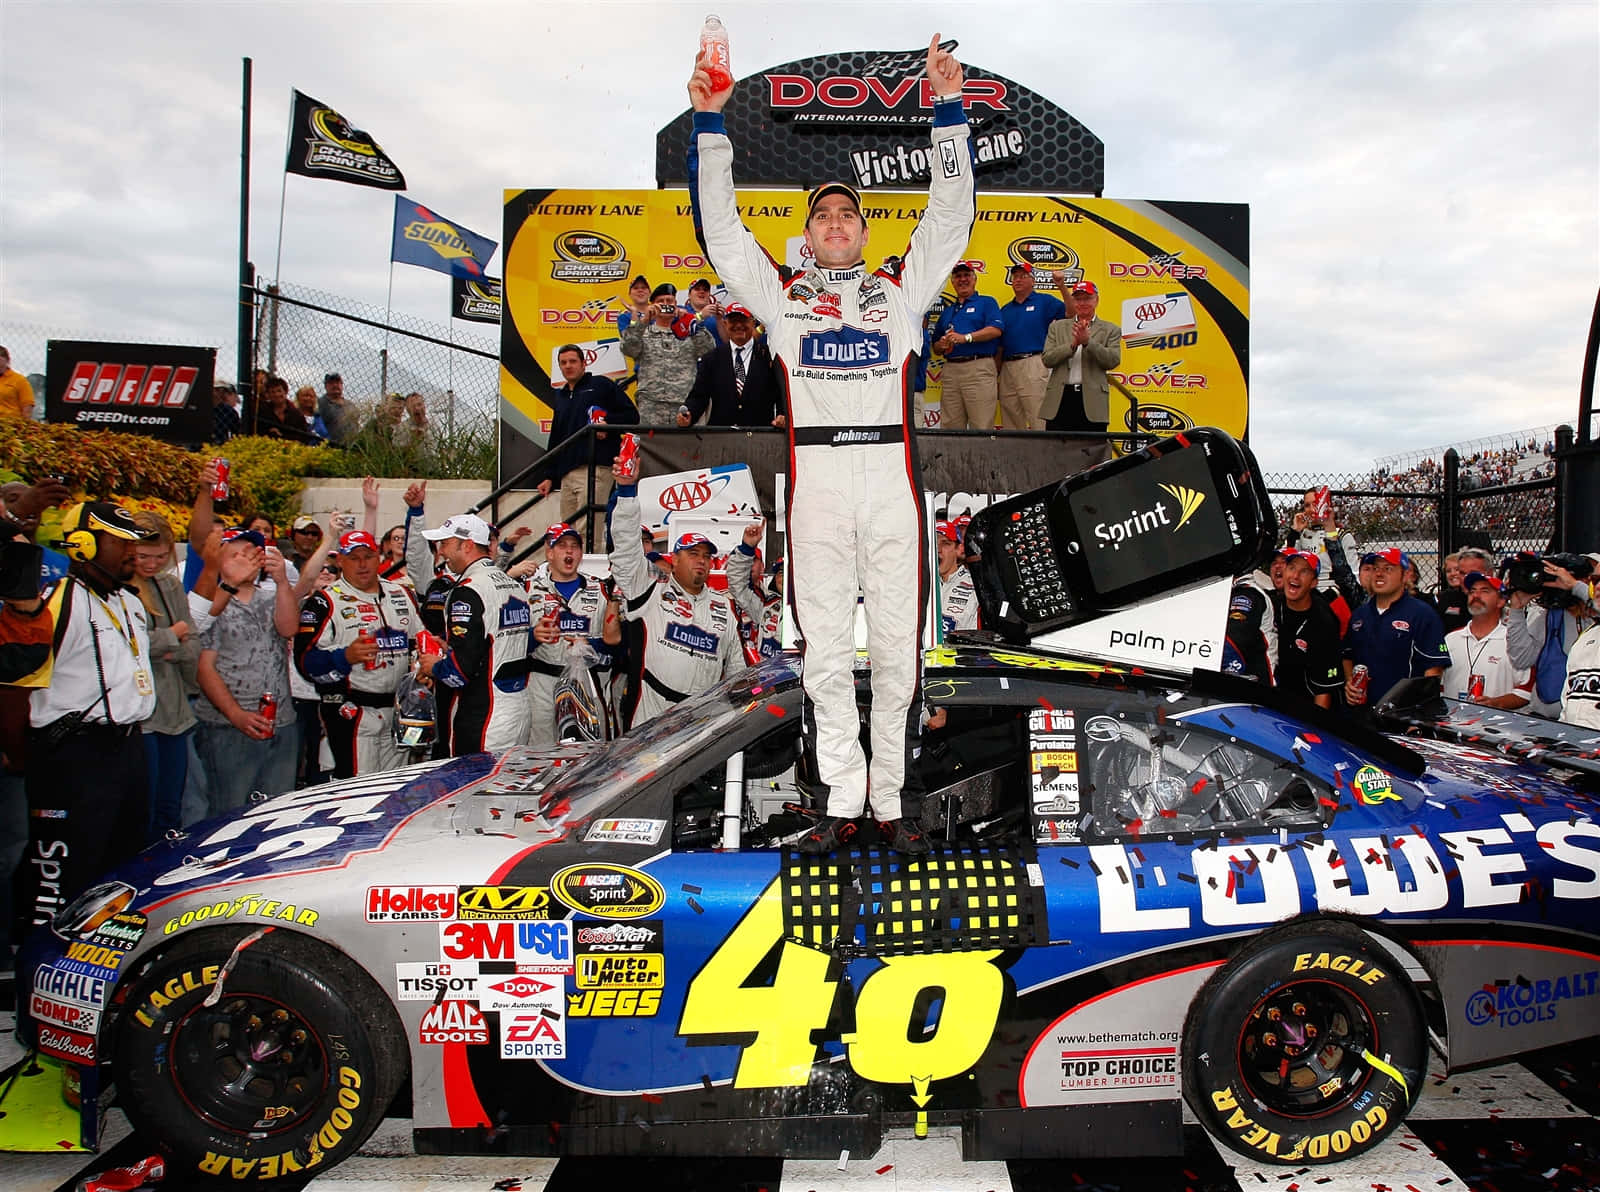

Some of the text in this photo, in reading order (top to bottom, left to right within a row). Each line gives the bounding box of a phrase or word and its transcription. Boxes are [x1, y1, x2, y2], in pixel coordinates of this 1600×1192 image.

[794, 113, 905, 123] INTERNATIONAL
[319, 145, 378, 165] CHASE
[852, 146, 934, 187] Victor
[974, 129, 1024, 164] ane
[367, 165, 397, 176] CUP
[600, 205, 645, 216] LANE
[747, 206, 793, 217] LANE
[1040, 212, 1084, 223] LANE
[578, 245, 600, 254] Sprint
[1032, 252, 1053, 260] Sprint
[1109, 263, 1208, 279] DOVER
[476, 302, 501, 311] CHA
[1136, 303, 1166, 321] AAA
[541, 309, 619, 324] DOVE
[1152, 331, 1198, 350] 400
[812, 338, 881, 361] LOWE'S
[806, 369, 825, 380] Build
[826, 371, 868, 381] Something
[870, 366, 898, 379] Together
[1107, 373, 1208, 389] DOVER
[67, 376, 192, 405] SPEED
[76, 410, 170, 425] SPEEDtv.com
[1148, 418, 1170, 427] Sprint
[833, 430, 880, 442] Johnson
[664, 482, 708, 511] AAA
[1095, 502, 1170, 550] Sprint
[560, 618, 585, 629] WE'S
[673, 627, 713, 649] LOWE'S
[1110, 630, 1165, 651] palm
[1030, 741, 1076, 751] Purolator
[1358, 771, 1391, 784] QUAKER
[1033, 783, 1079, 793] SIEMENS
[1367, 779, 1391, 792] STATE
[615, 821, 653, 832] NASCAR
[625, 833, 652, 842] CAR
[584, 875, 624, 886] NASCAR
[1088, 812, 1600, 934] LOWE'S
[32, 840, 69, 926] Sprin
[589, 887, 627, 902] Sprint
[369, 888, 455, 919] Holley
[164, 893, 319, 935] GOODYEAR
[369, 911, 440, 920] HP CARBS
[459, 909, 549, 921] MECHANIX WEAR
[93, 936, 134, 950] BELTS
[443, 923, 515, 959] 3M
[518, 922, 569, 960] USG
[578, 928, 657, 943] Coors LIGHT
[65, 941, 125, 969] MOOG
[602, 958, 648, 970] Auto
[1293, 952, 1387, 986] EAGLE
[89, 967, 115, 981] PARTS
[600, 971, 658, 983] Meter
[678, 858, 1017, 1090] 48
[35, 965, 104, 1004] MAHLE
[399, 978, 478, 991] TISSOT
[1497, 971, 1599, 1011] KOBALT
[32, 997, 80, 1023] COMP
[568, 990, 663, 1016] JEGS
[421, 1001, 487, 1030] MAC
[1497, 1003, 1557, 1028] TOOLS
[505, 1016, 561, 1042] EA
[39, 1029, 95, 1060] Edelbrock
[422, 1032, 487, 1042] TOOLS
[1057, 1031, 1179, 1044] www.bethematch.org
[504, 1044, 562, 1056] SPORTS
[1061, 1058, 1177, 1077] TOP CHOICE
[1061, 1074, 1176, 1088] LUMBER PRODUCTS
